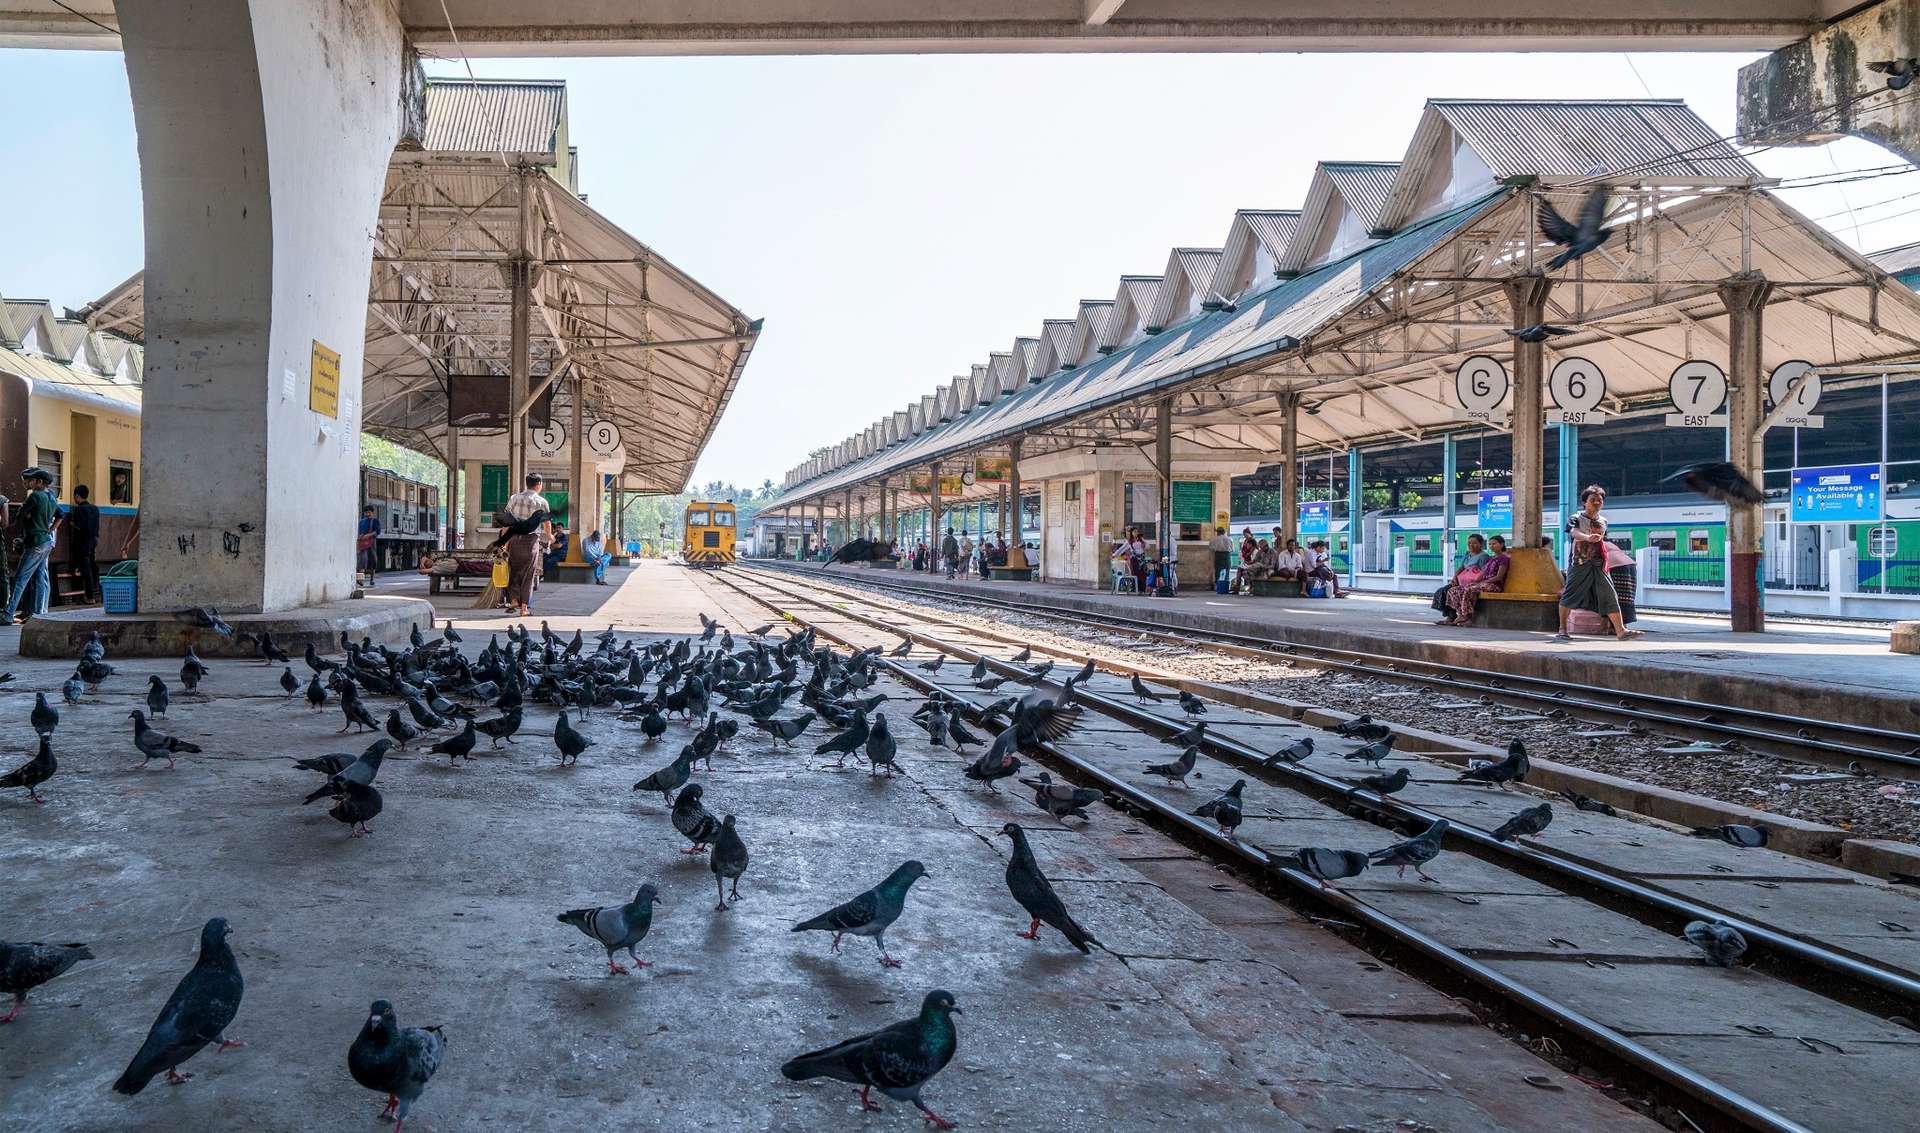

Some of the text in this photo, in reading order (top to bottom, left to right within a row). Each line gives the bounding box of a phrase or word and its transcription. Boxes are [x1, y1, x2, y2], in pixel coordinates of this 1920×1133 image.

[1471, 369, 1490, 396] ၆
[1568, 372, 1586, 399] 6
[1687, 376, 1707, 404] 7
[1563, 411, 1586, 423] EAST
[1684, 415, 1709, 426] EAST
[544, 428, 555, 444] 5
[541, 450, 555, 458] EAST
